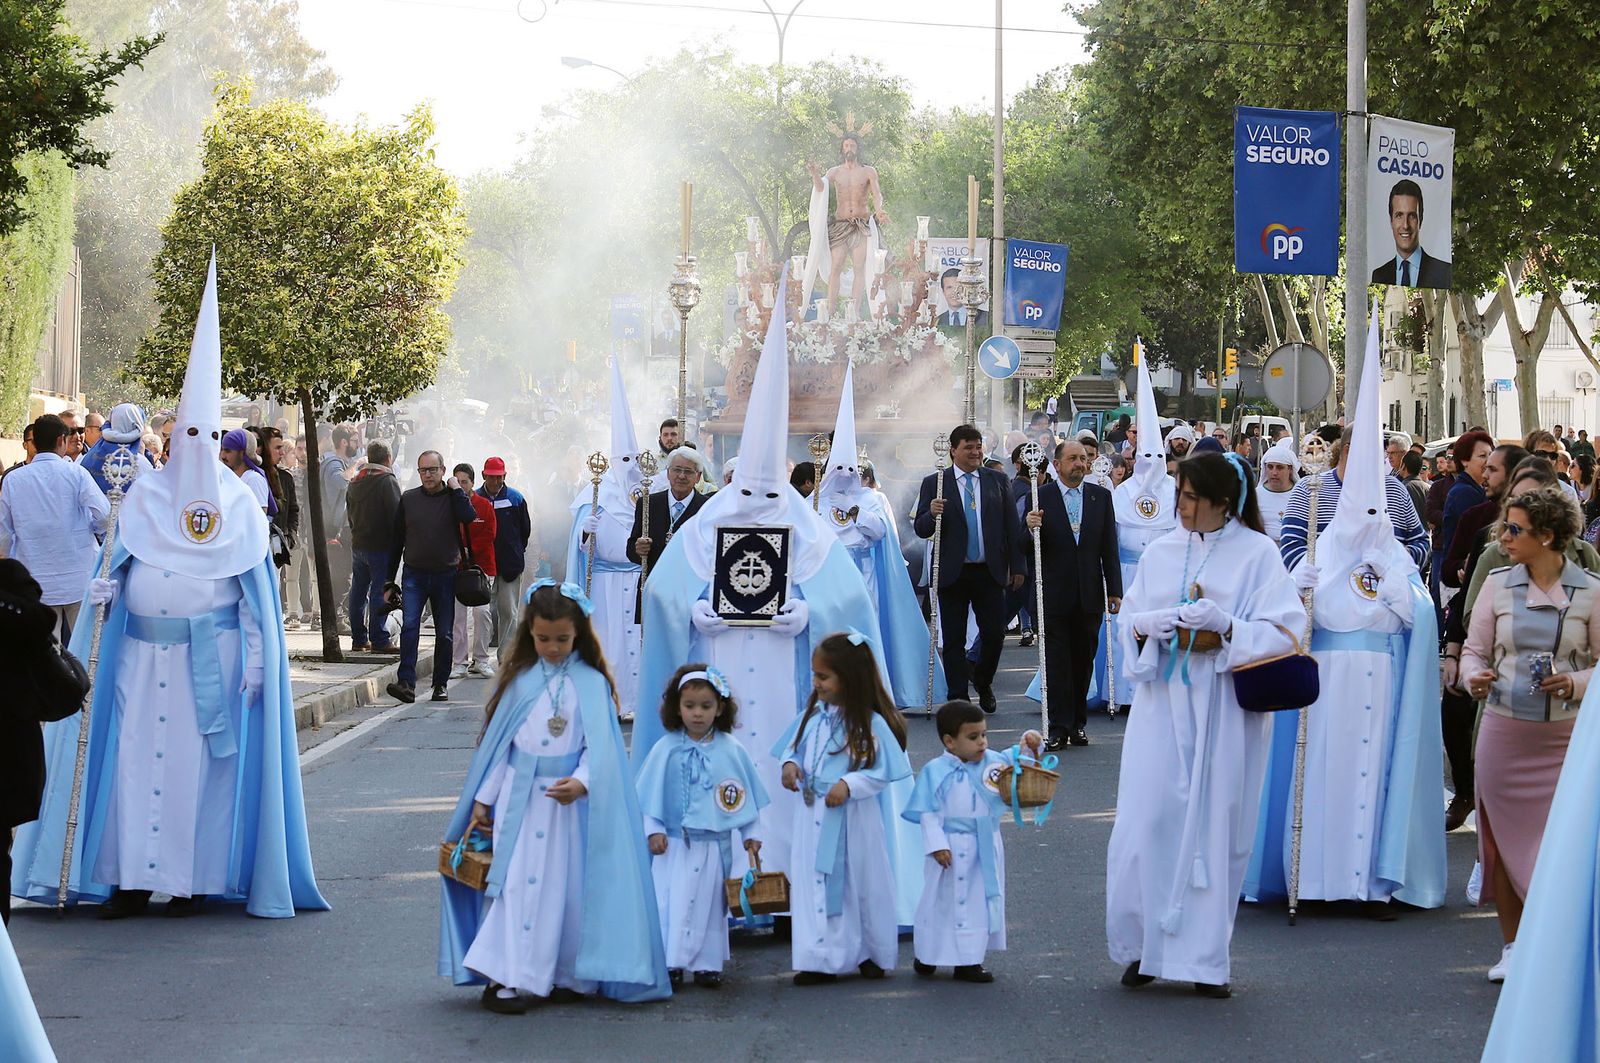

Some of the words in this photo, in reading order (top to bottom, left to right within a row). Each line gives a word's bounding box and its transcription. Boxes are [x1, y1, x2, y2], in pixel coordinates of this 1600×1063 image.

[1246, 123, 1312, 145] VALOR
[1246, 145, 1330, 166] SEGURO
[1378, 135, 1429, 158] PABLO
[1377, 156, 1444, 180] CASADO
[1013, 247, 1052, 261] VALOR
[1013, 258, 1061, 273] SEGURO
